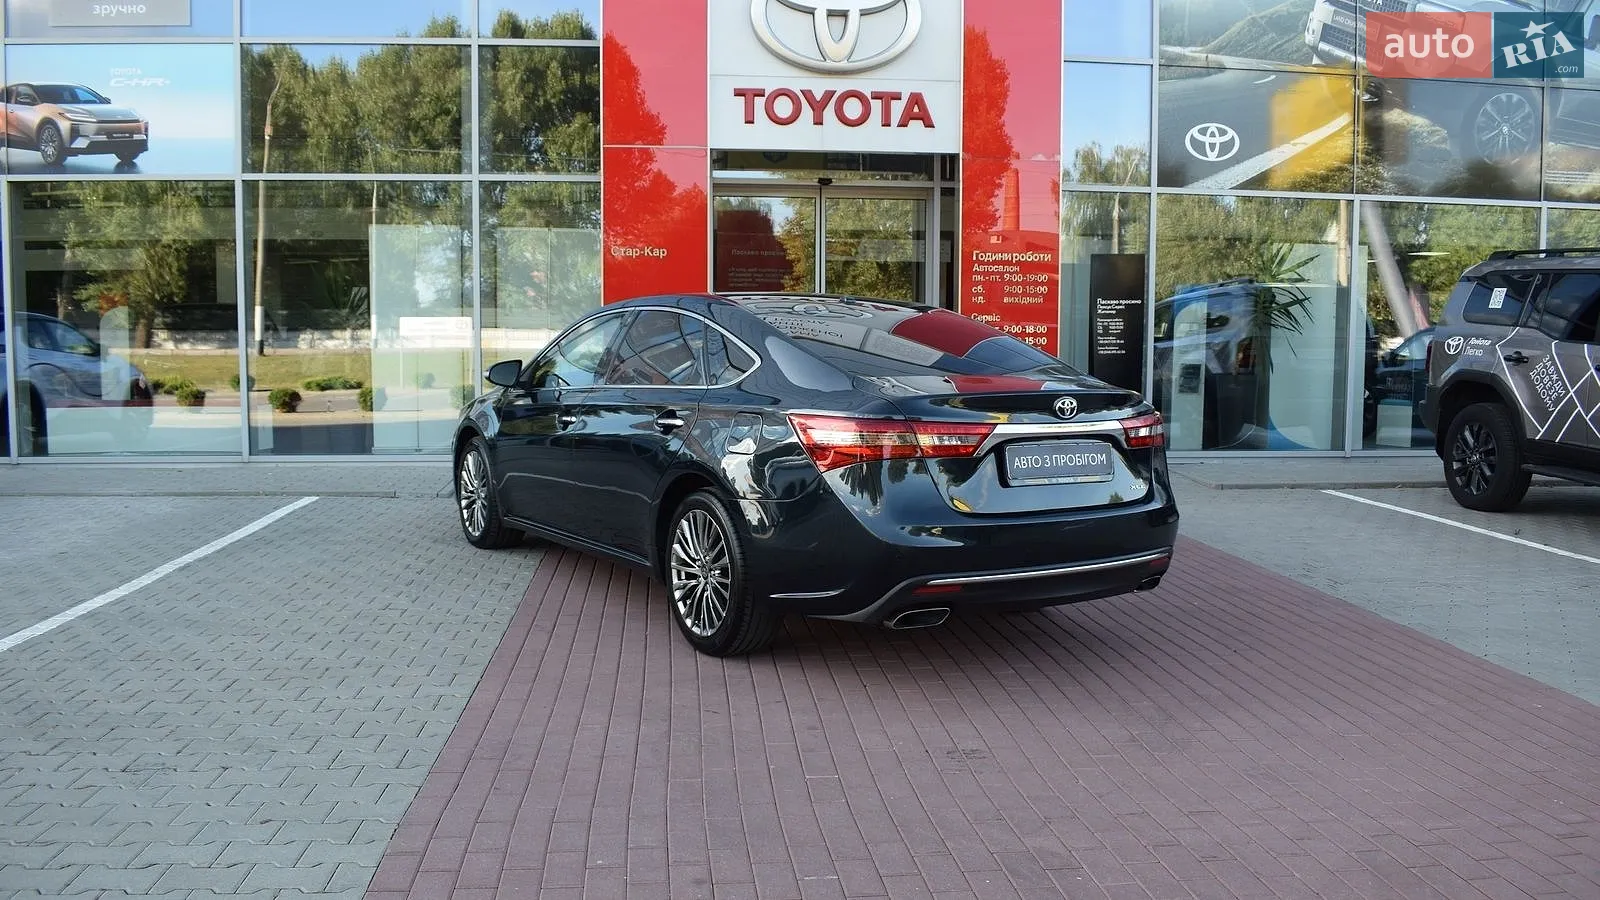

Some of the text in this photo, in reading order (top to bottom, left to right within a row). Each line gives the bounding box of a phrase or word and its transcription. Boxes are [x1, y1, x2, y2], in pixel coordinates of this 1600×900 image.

[92, 4, 146, 17] зручно
[733, 88, 936, 129] TOYOTA
[611, 245, 667, 260] Стар-Кар
[972, 250, 1052, 263] Години роботи
[972, 263, 1020, 272] Автосалон
[971, 285, 986, 293] сб.
[972, 295, 1043, 304] нд. вихідний
[971, 312, 1001, 324] Сервіс
[1535, 362, 1558, 401] ДОВЕЗЕ
[1542, 354, 1566, 397] ЗАВЖДИ
[1529, 370, 1555, 412] ДОДОМУ
[1014, 455, 1042, 469] АВТО
[1052, 453, 1107, 467] ПРОБІГОМ
